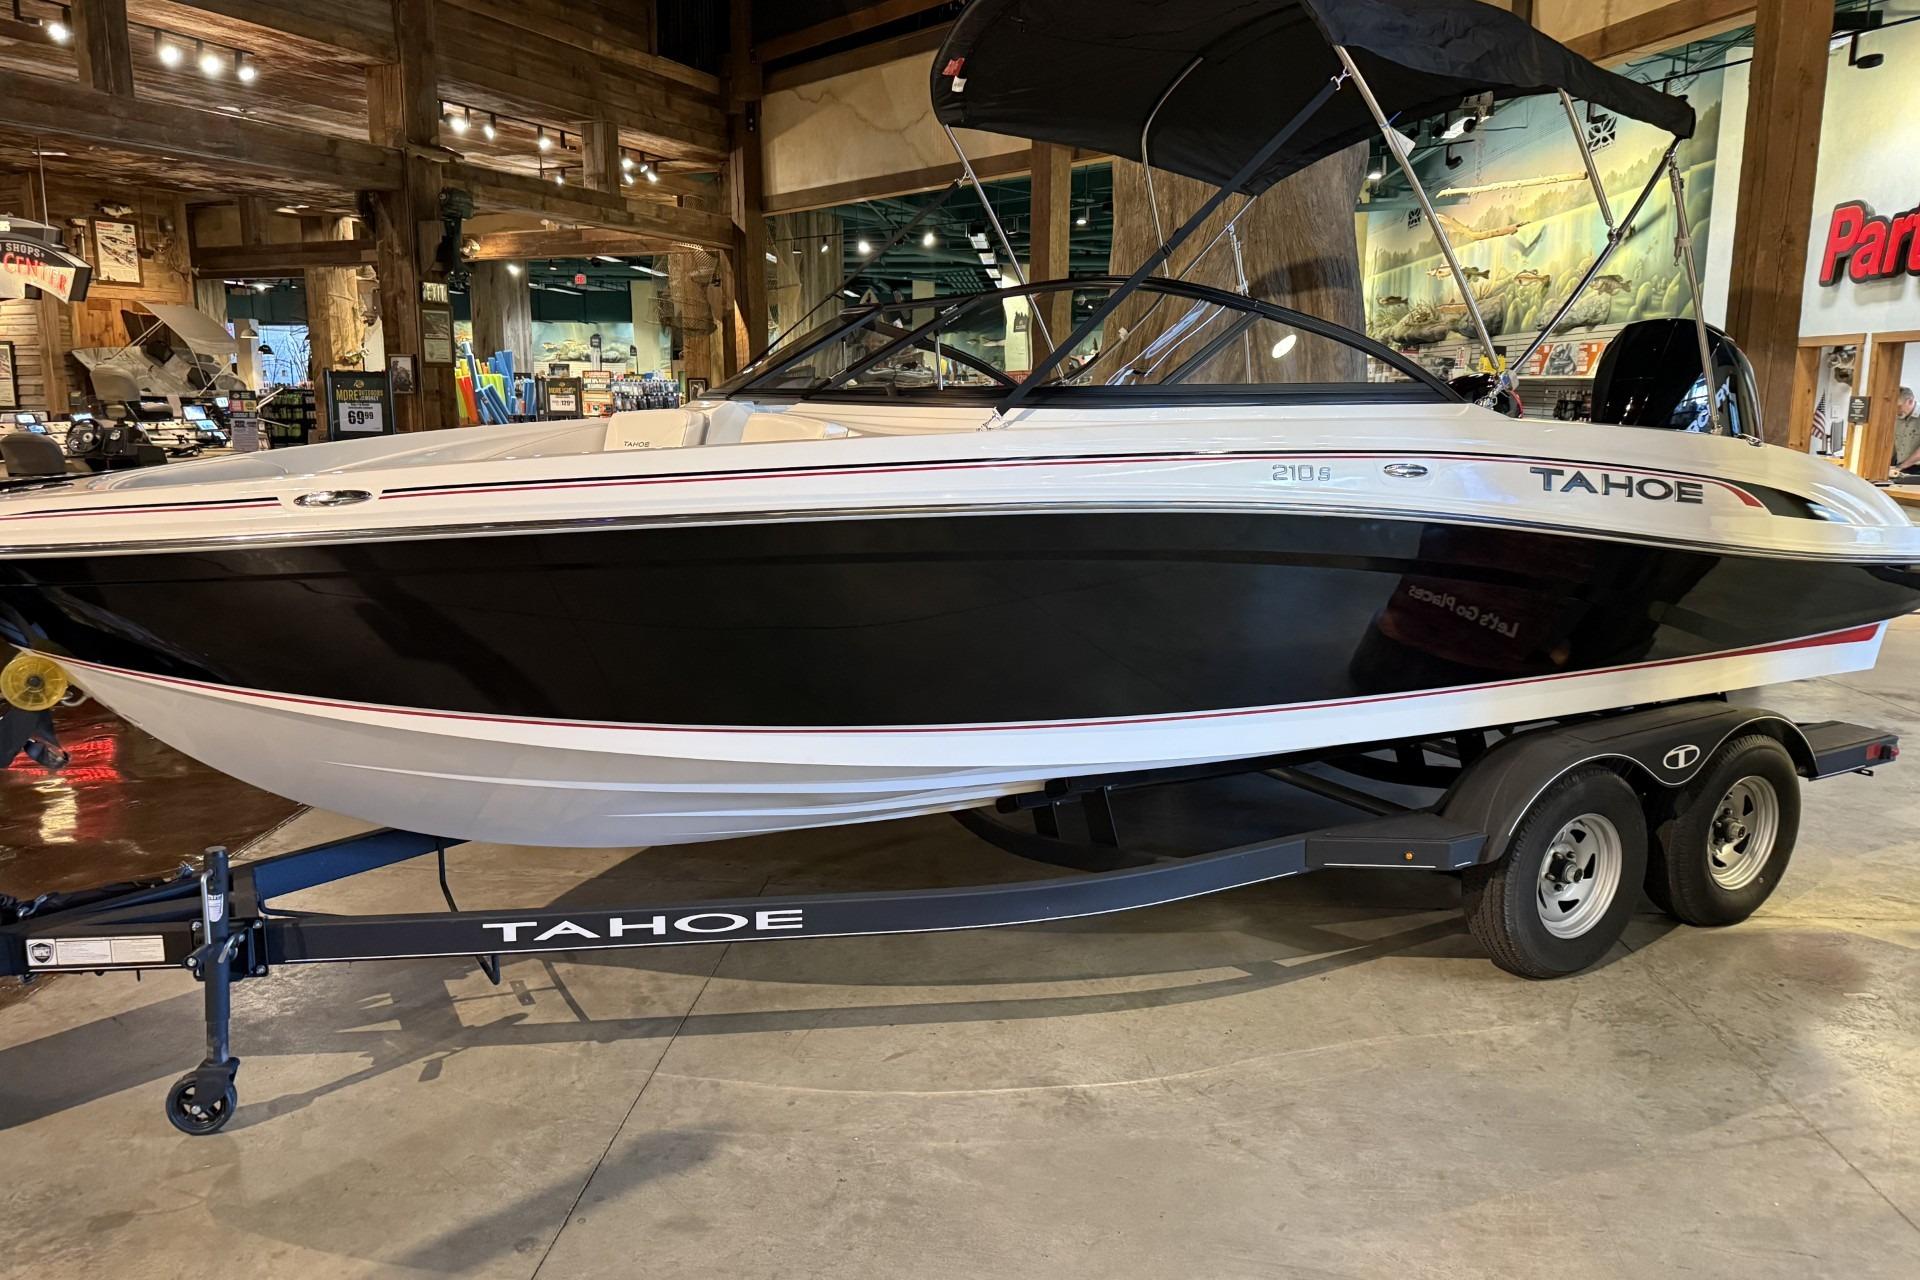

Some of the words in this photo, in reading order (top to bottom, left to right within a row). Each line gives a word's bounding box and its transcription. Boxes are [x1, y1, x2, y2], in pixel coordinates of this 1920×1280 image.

[5, 242, 41, 258] SHOPS
[3, 252, 68, 294] CENTER
[426, 283, 445, 302] EXIT
[336, 389, 358, 401] MORE
[623, 440, 650, 448] TAHOE
[1272, 464, 1314, 481] 210
[1529, 467, 1704, 504] TAHOE
[482, 909, 803, 942] TAHOE
